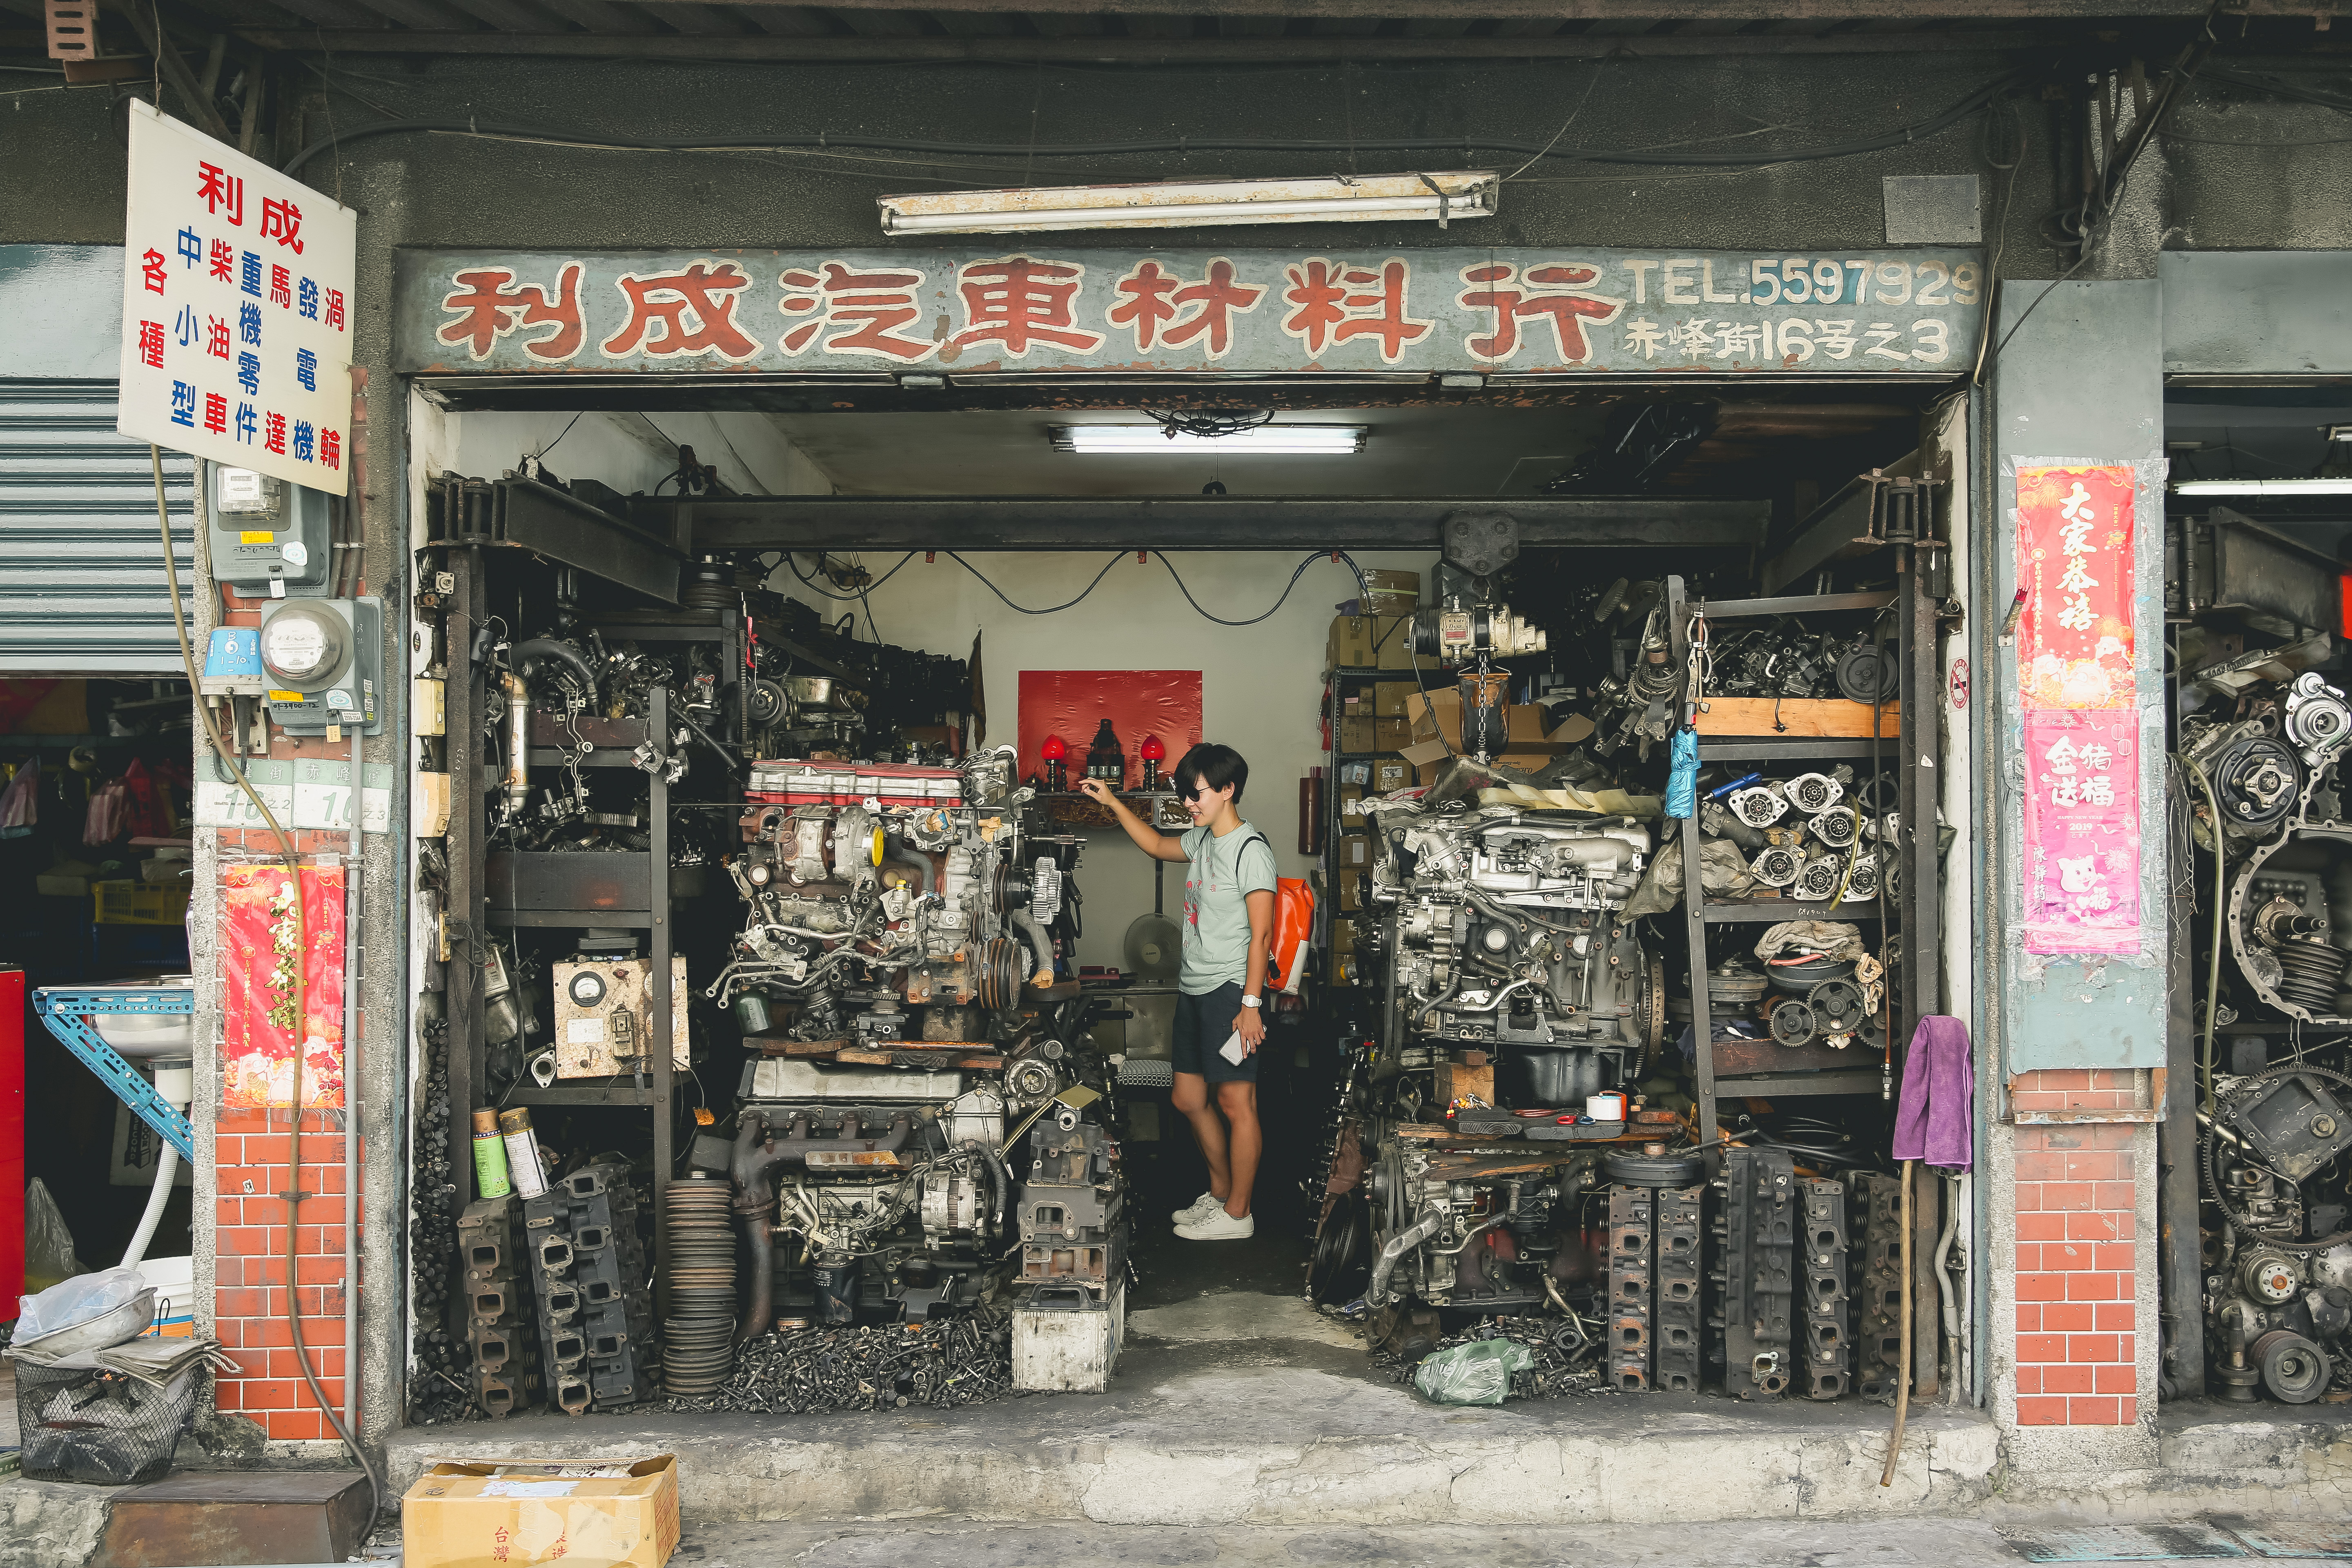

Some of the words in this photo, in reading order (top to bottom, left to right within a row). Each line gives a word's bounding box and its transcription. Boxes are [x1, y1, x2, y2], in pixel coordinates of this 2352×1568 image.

[197, 160, 305, 256] 利成
[138, 247, 168, 370] 各種
[171, 225, 202, 428] 中小型
[203, 238, 233, 435] 柴油車
[235, 249, 263, 445] 重機零件
[264, 263, 292, 456] 馬達
[292, 276, 319, 464] 發電機
[320, 286, 345, 471] 渦輪
[436, 252, 1627, 363] 利成汽車材料行
[2055, 481, 2100, 632] 大家恭禧
[2090, 886, 2111, 911] 福
[130, 1116, 139, 1160] SECOND
[493, 1526, 510, 1563] 台灣
